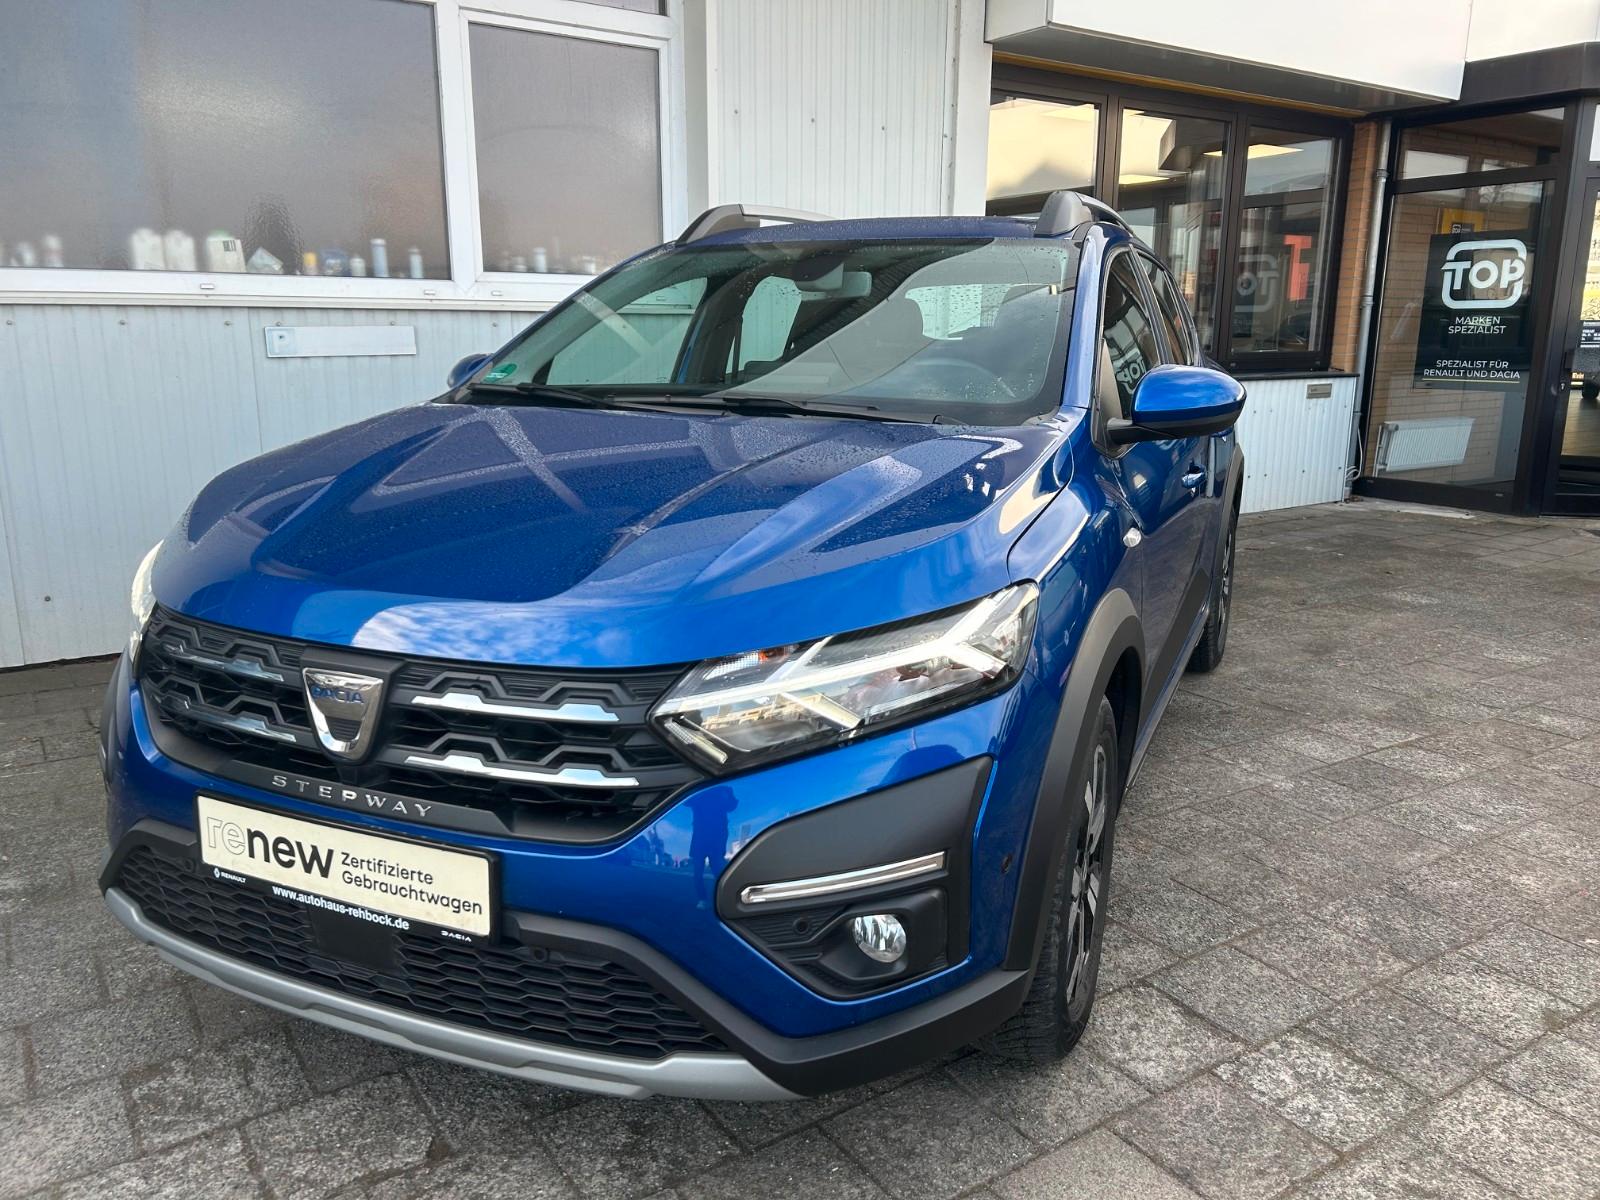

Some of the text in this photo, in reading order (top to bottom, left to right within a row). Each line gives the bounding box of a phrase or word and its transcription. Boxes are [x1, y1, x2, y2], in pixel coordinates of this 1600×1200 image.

[1441, 258, 1526, 290] TOP
[1448, 325, 1506, 334] SPEZIALIST
[1455, 316, 1500, 325] MARKEN
[1423, 368, 1520, 379] RENAULT UND DACIA
[1436, 359, 1509, 369] SPEZIALIST FÜR
[311, 685, 365, 705] DACIA
[272, 775, 431, 817] STEPWAY
[206, 816, 334, 879] renew
[221, 871, 247, 883] RENAULT
[341, 852, 434, 885] Zertifizierte
[342, 871, 482, 915] Gebrauchtwagen
[272, 885, 410, 930] www.autohaus-rehbock.de
[441, 930, 472, 942] DACIA
